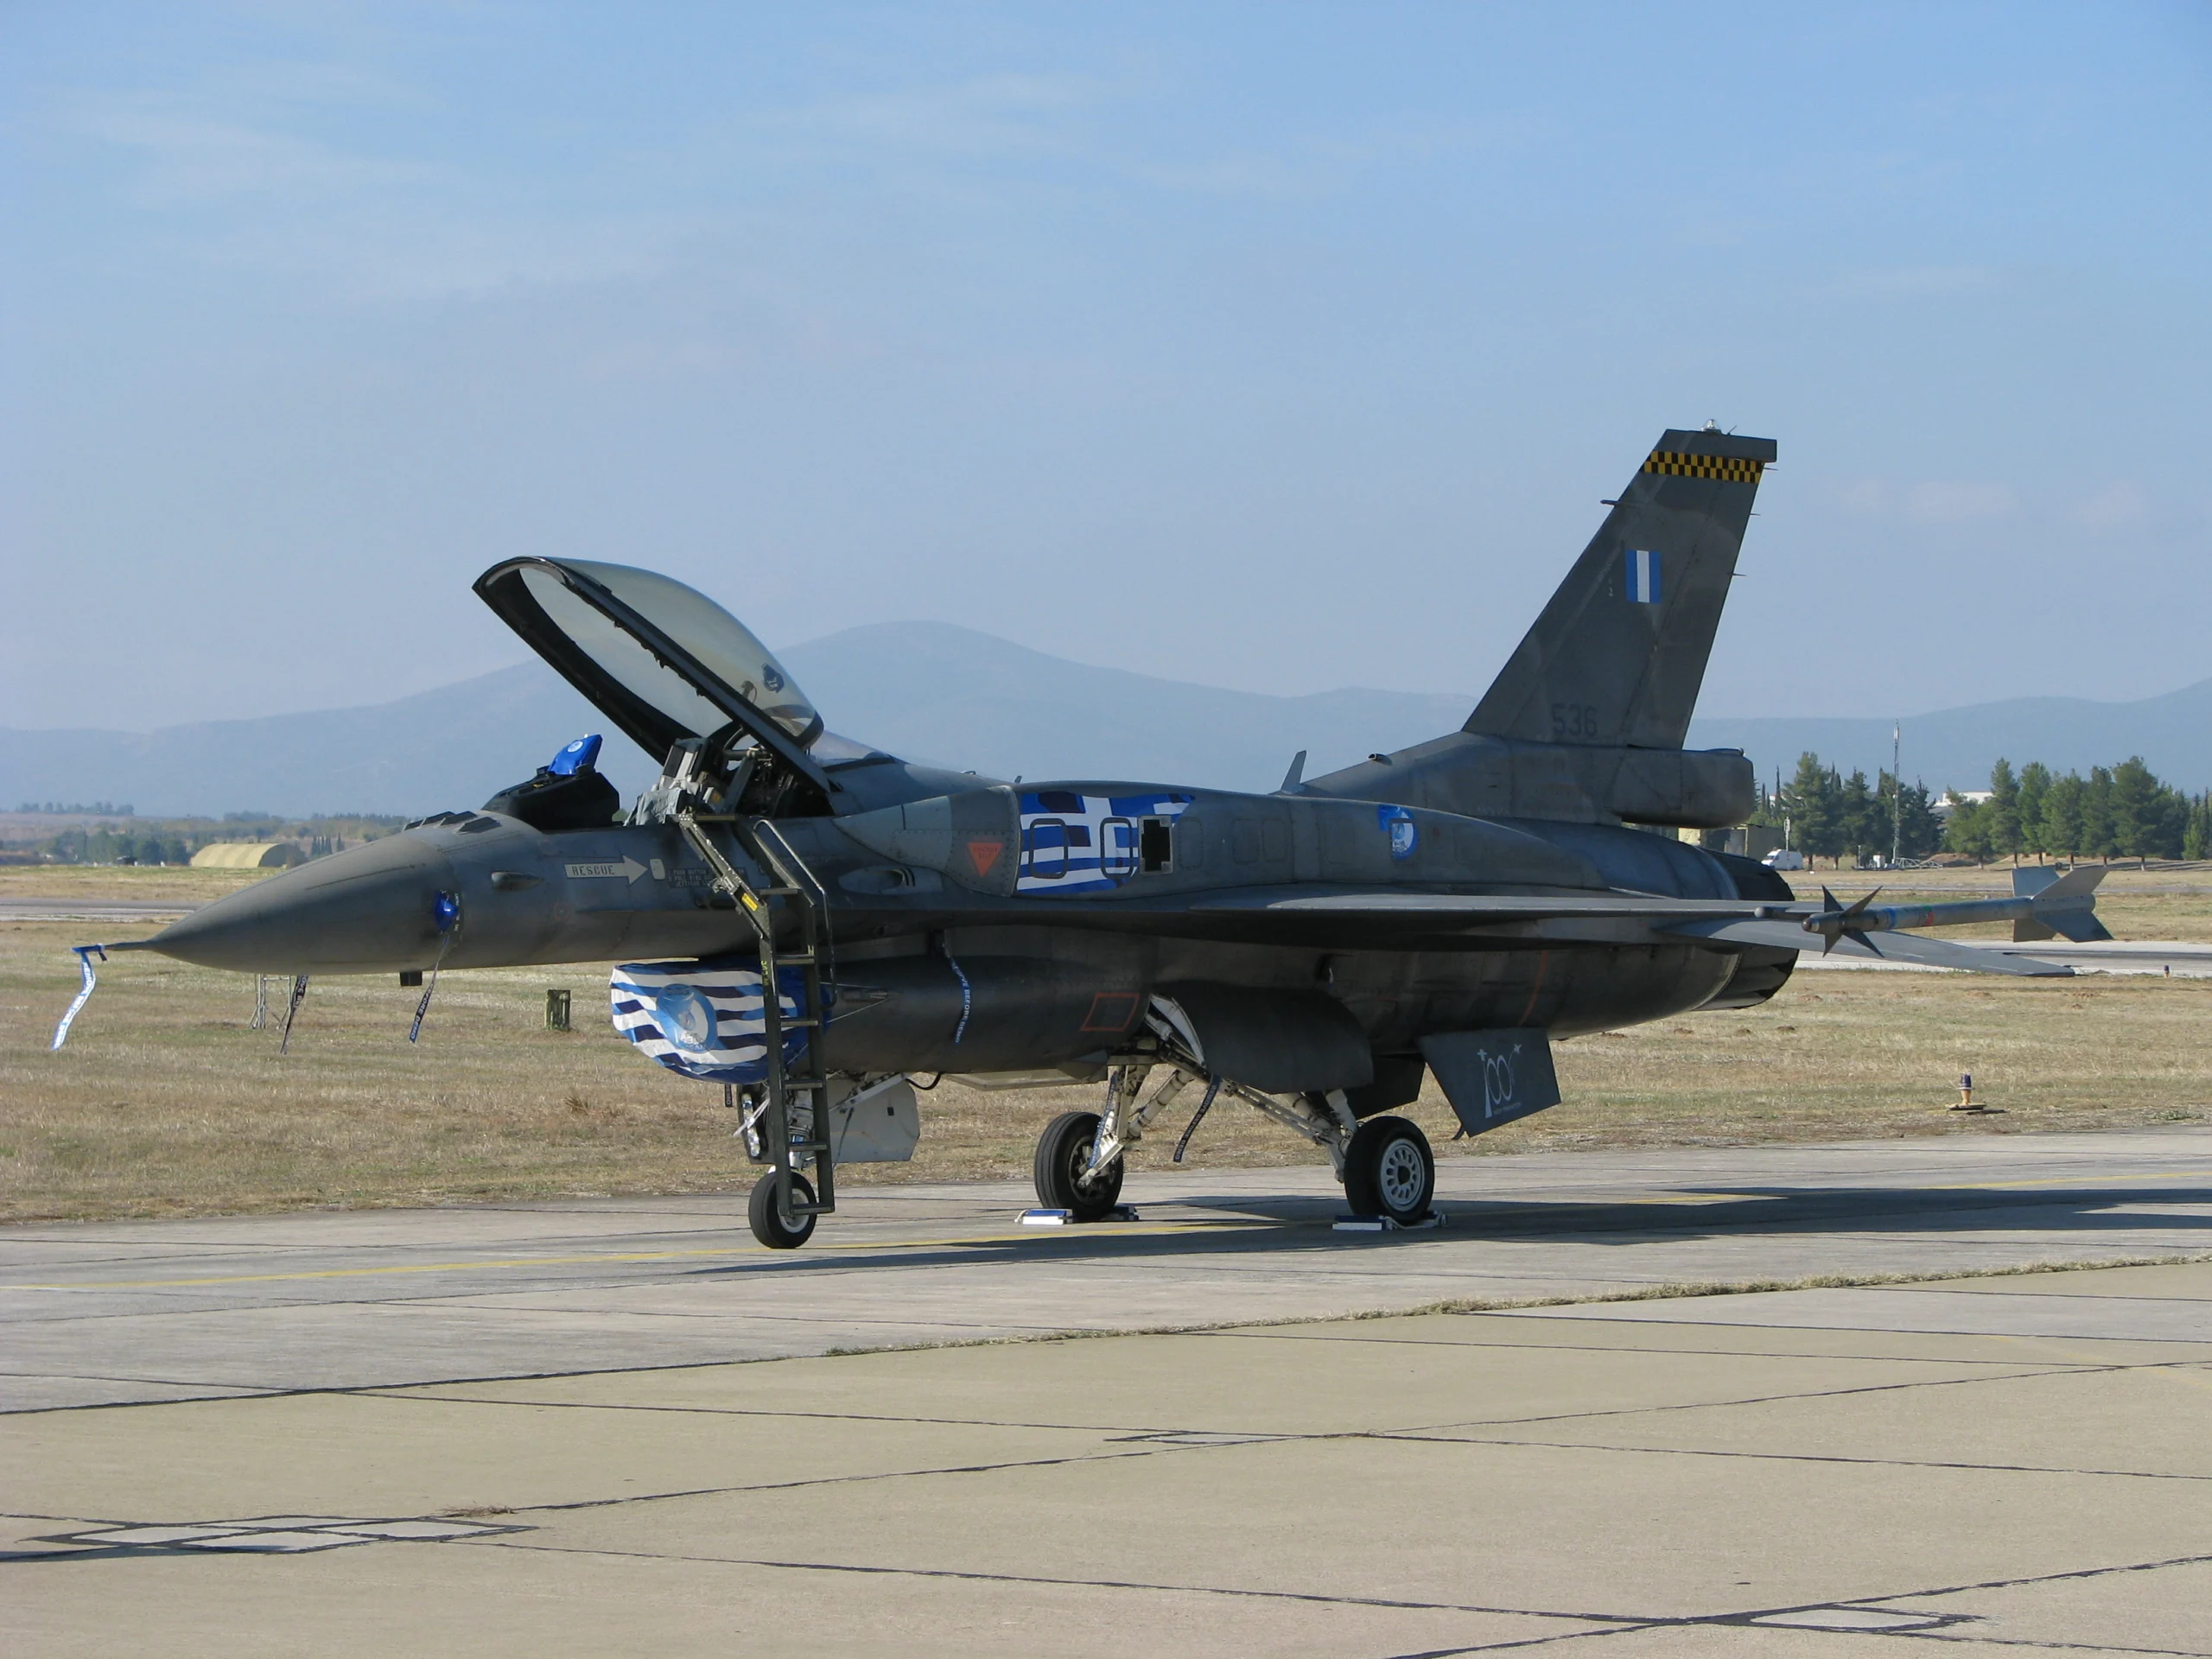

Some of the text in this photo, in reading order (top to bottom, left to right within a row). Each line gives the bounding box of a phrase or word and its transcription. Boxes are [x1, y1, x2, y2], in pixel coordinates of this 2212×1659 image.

[1552, 702, 1598, 736] 536
[571, 864, 615, 876] RESCUE
[963, 989, 971, 1020] BEFORE
[410, 1015, 421, 1039] DEMO
[955, 1021, 965, 1043] DEMO
[1175, 1140, 1186, 1160] DEMO
